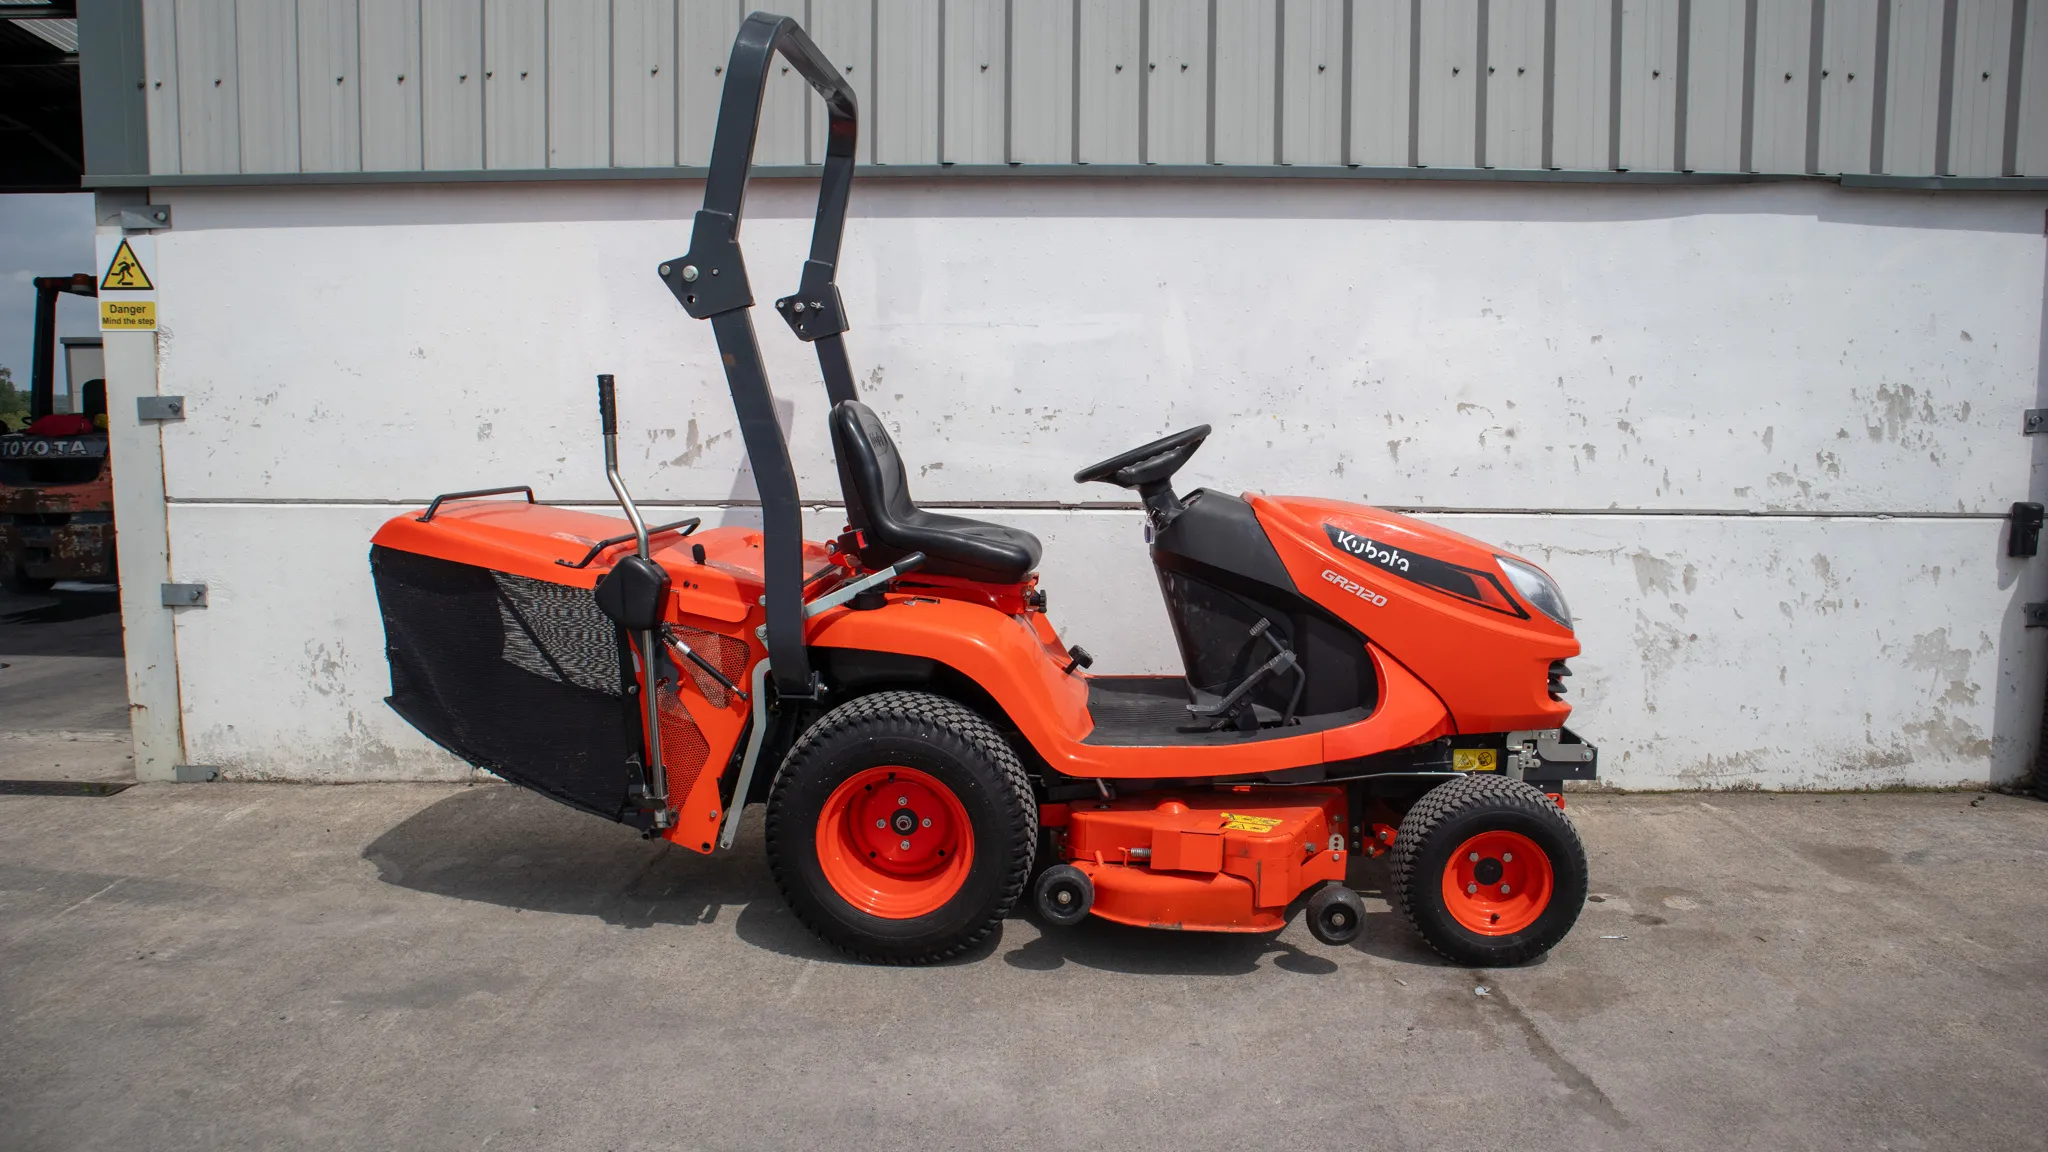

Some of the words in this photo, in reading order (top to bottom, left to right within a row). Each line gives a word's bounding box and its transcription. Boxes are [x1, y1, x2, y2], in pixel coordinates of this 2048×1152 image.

[109, 304, 146, 316] Danger
[102, 317, 122, 325] Mind
[123, 317, 136, 325] the
[137, 318, 155, 326] step
[3, 440, 87, 456] TOYOTA
[1337, 530, 1410, 572] Kubota
[1321, 569, 1388, 607] GR2120
